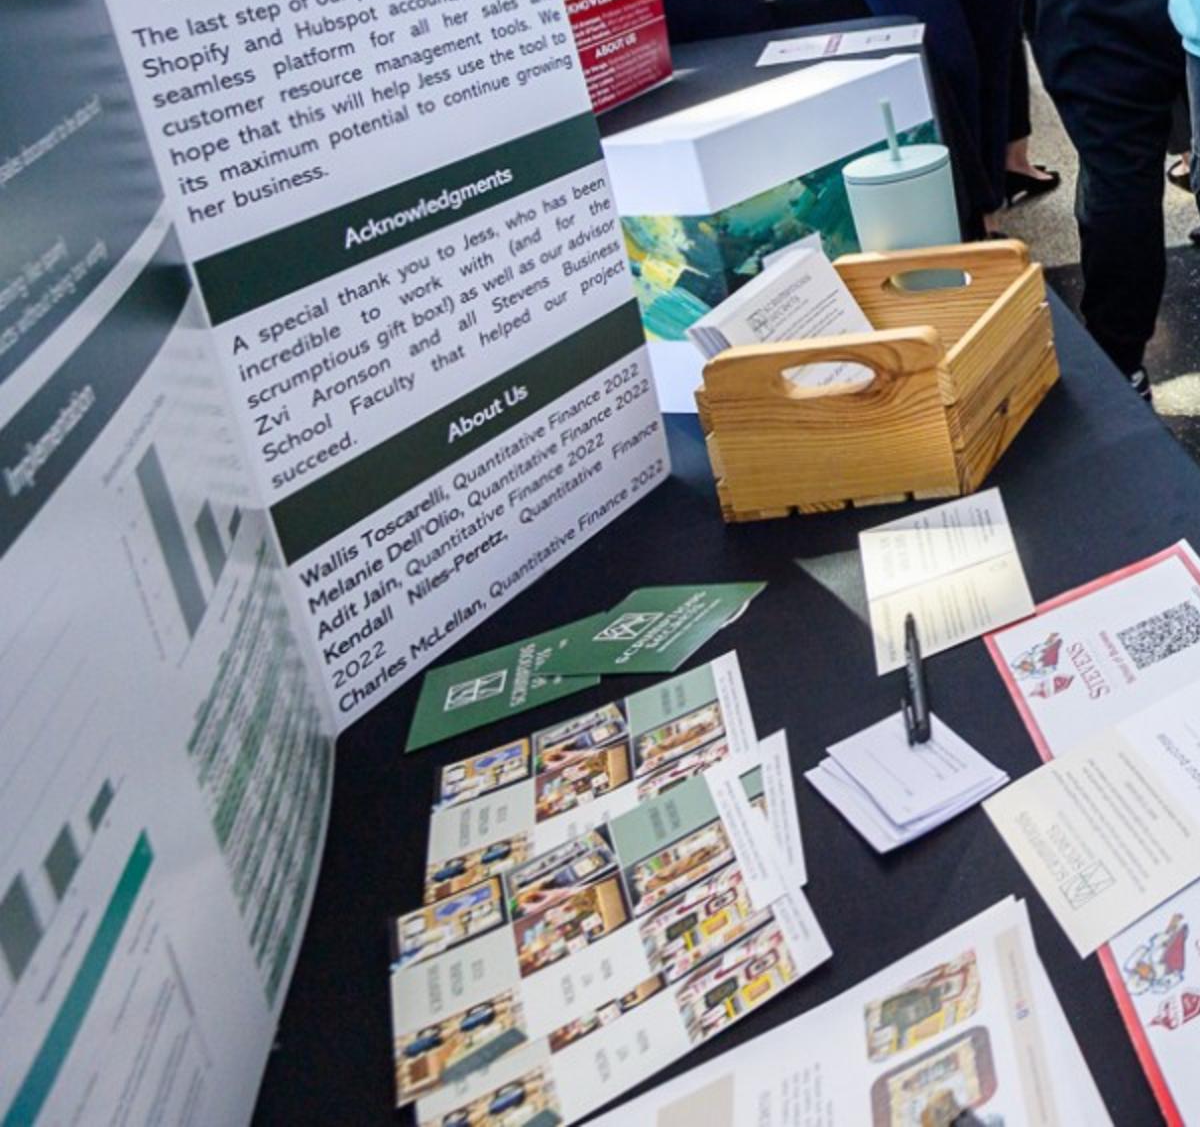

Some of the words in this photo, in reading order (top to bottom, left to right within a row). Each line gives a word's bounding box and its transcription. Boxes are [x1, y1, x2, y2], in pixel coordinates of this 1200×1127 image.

[132, 26, 180, 48] The
[187, 12, 229, 37] last
[234, 3, 281, 26] step
[142, 42, 230, 78] Shopify
[244, 30, 284, 53] and
[294, 8, 379, 41] Hubspot
[162, 93, 265, 137] customer
[279, 65, 363, 104] resource
[375, 30, 483, 76] management
[490, 16, 532, 40] tools.
[538, 8, 561, 25] We
[187, 197, 225, 223] her
[233, 164, 329, 208] business.
[233, 335, 249, 355] A
[257, 296, 330, 343] special
[337, 272, 391, 307] thank
[398, 256, 430, 284] you
[437, 245, 456, 261] to
[463, 227, 500, 251] Jess,
[505, 208, 537, 230] who
[542, 194, 567, 214] has
[572, 177, 607, 200] been
[344, 167, 514, 250] Acknowledgments
[239, 322, 342, 383] incredible
[361, 307, 381, 324] to
[398, 275, 443, 306] work
[458, 251, 494, 277] with
[508, 230, 542, 258] (and
[555, 213, 576, 233] for
[589, 197, 611, 217] the
[254, 405, 291, 437] Zvi
[311, 356, 392, 408] Aronson
[408, 329, 442, 357] and
[458, 311, 477, 333] all
[491, 275, 550, 315] Stevens
[561, 239, 621, 277] Business
[261, 412, 333, 463] School
[349, 371, 416, 416] Faculty
[430, 345, 465, 372] that
[479, 309, 532, 347] helped
[543, 290, 568, 312] our
[580, 259, 626, 296] project
[271, 437, 358, 490] succeed.
[299, 546, 359, 588] Wallis
[360, 486, 451, 548] Toscarelli,
[452, 426, 546, 491] Quantitative
[548, 390, 601, 430] Finance
[604, 362, 640, 395] 2022
[447, 402, 503, 444] About
[504, 384, 529, 406] Us
[307, 560, 385, 615] Melanie
[387, 509, 465, 561] Dell'Olio,
[467, 441, 559, 509] Quantitative
[560, 403, 613, 444] Finance
[615, 378, 650, 411] 2022
[316, 603, 362, 639] Adit
[363, 578, 404, 612] Jain,
[405, 504, 506, 578] Quantitative
[508, 465, 567, 508] Finance
[568, 432, 605, 466] 2022
[322, 605, 395, 665] Kendall
[406, 530, 509, 606] Niles-Peretz,
[519, 461, 603, 526] Quantitative
[610, 419, 660, 460] Finance
[338, 654, 409, 714] Charles
[411, 600, 489, 659] McLellan,
[488, 526, 576, 599] Quantitative
[577, 488, 629, 532] Finance
[631, 458, 664, 494] 2022
[332, 640, 386, 690] 2022
[1066, 642, 1111, 701] STEVENS
